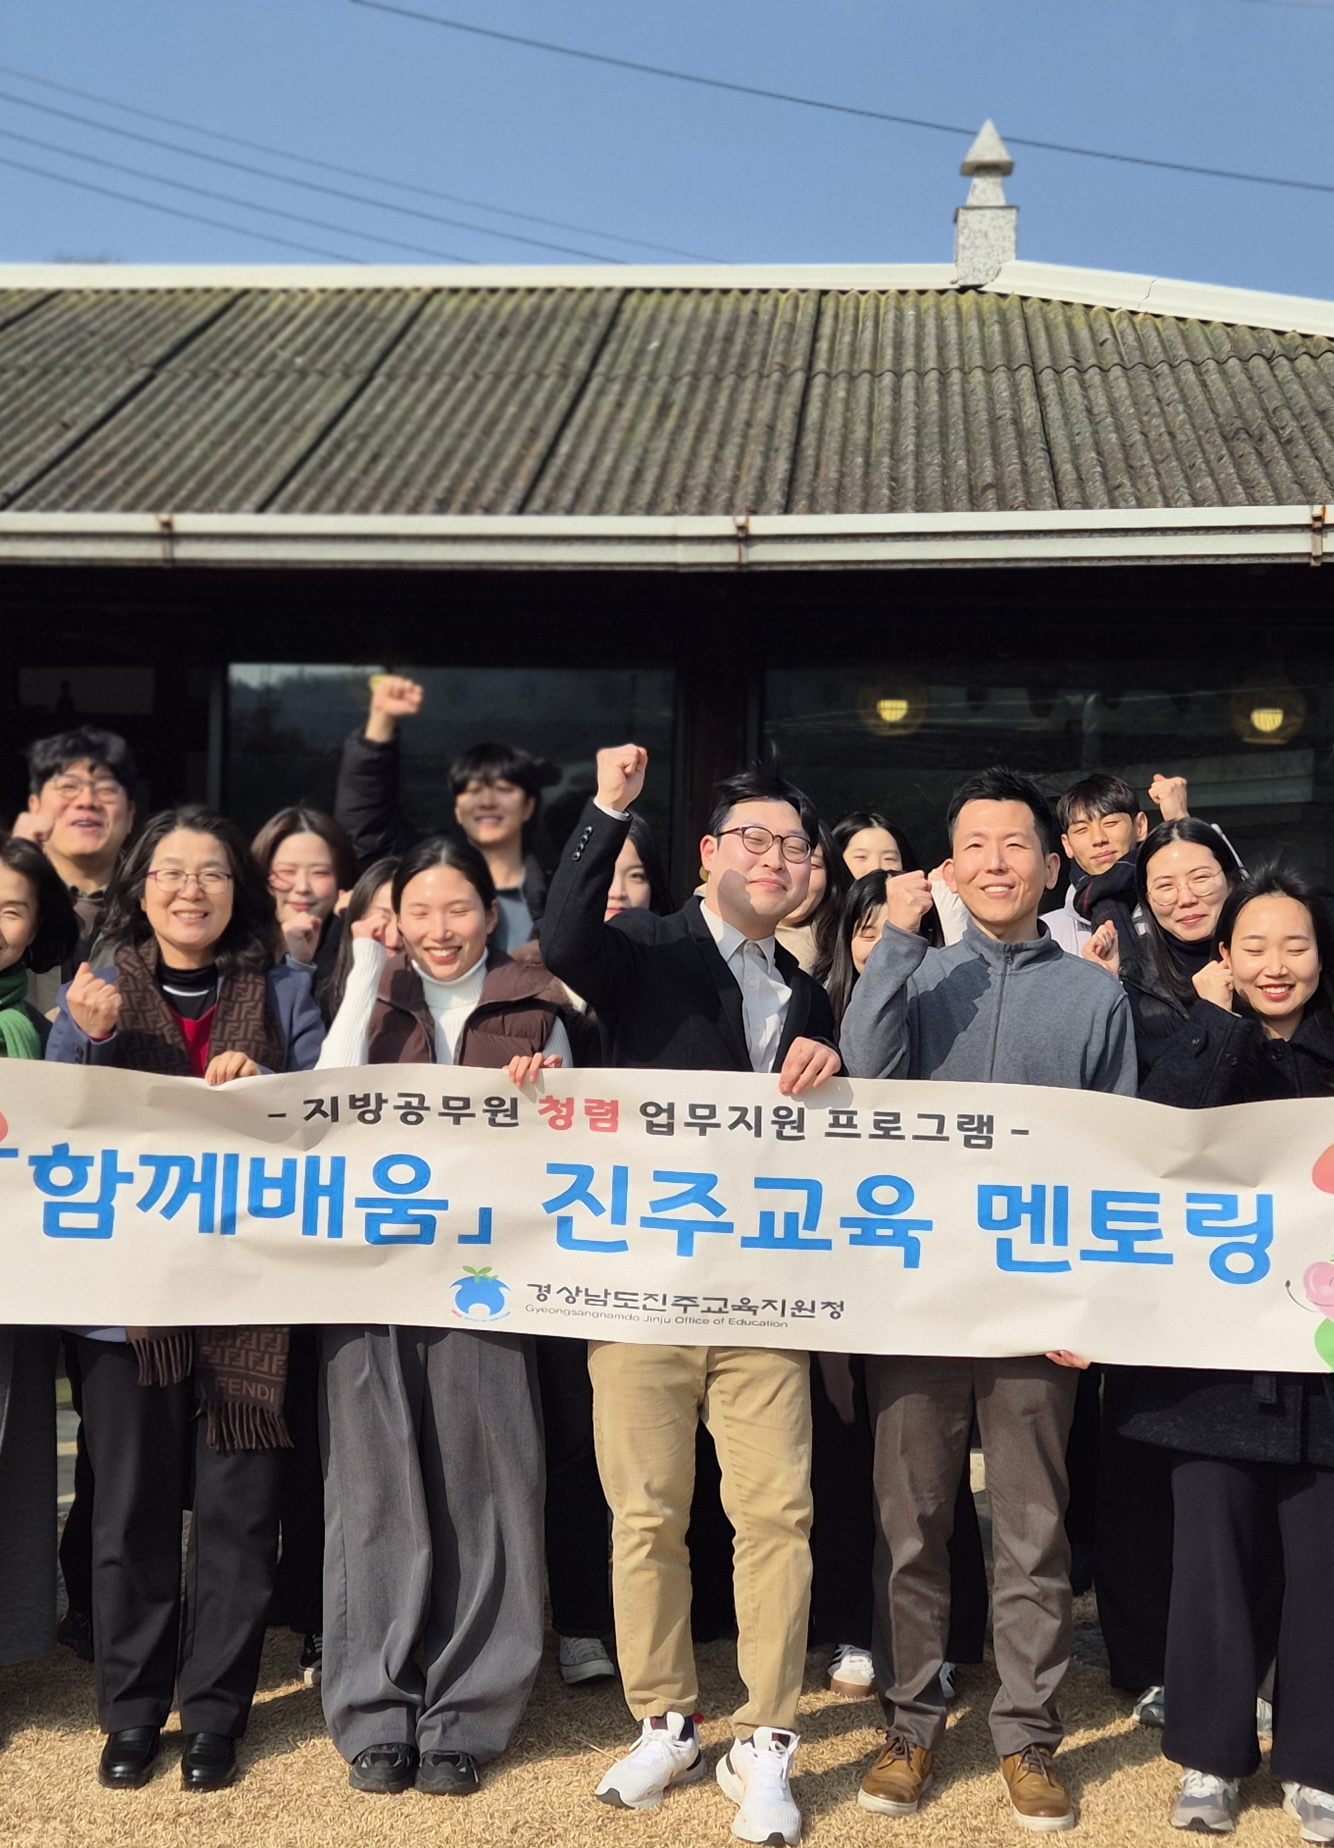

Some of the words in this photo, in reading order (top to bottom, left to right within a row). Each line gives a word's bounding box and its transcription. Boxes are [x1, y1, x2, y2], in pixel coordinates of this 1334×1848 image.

[302, 1091, 520, 1129] 지방공무원
[538, 1095, 620, 1134] 청렴
[638, 1101, 807, 1142] 업무지원
[824, 1109, 995, 1150] 프로그램
[543, 1163, 934, 1270] 진주교육
[977, 1183, 1274, 1285] 멘토링
[525, 1304, 641, 1323] Gyeongsangnamdo
[643, 1316, 671, 1325] Jinju
[674, 1315, 710, 1326] Office
[713, 1317, 725, 1326] of
[728, 1317, 789, 1329] Education
[526, 1283, 845, 1320] 경상남도진주교육지원청
[217, 1378, 275, 1403] FENDI
